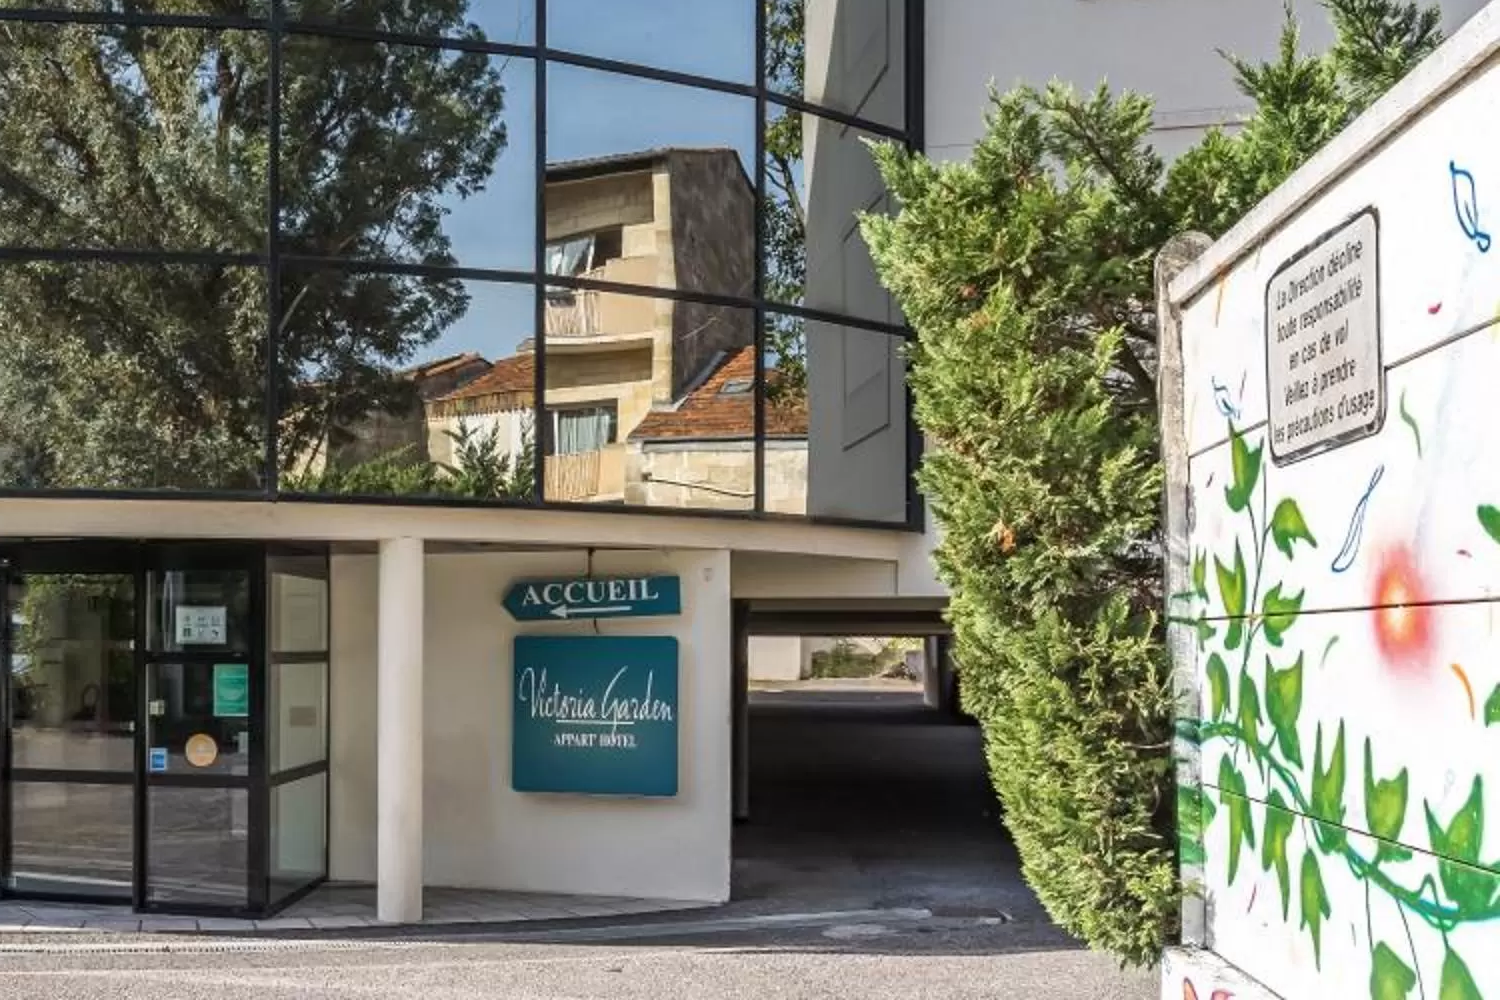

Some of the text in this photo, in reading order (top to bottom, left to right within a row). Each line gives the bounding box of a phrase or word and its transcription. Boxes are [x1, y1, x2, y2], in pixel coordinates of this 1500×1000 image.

[1288, 264, 1325, 303] Direction
[1327, 239, 1363, 277] décline
[1277, 273, 1363, 343] toute responsabilité
[1289, 317, 1349, 371] en cas de vol
[1283, 380, 1309, 408] Veillez
[1319, 356, 1357, 397] prendre
[1273, 388, 1376, 445] les précautions d'usage
[522, 578, 660, 607] ACCUEIL
[517, 664, 674, 736] Victoria Garden
